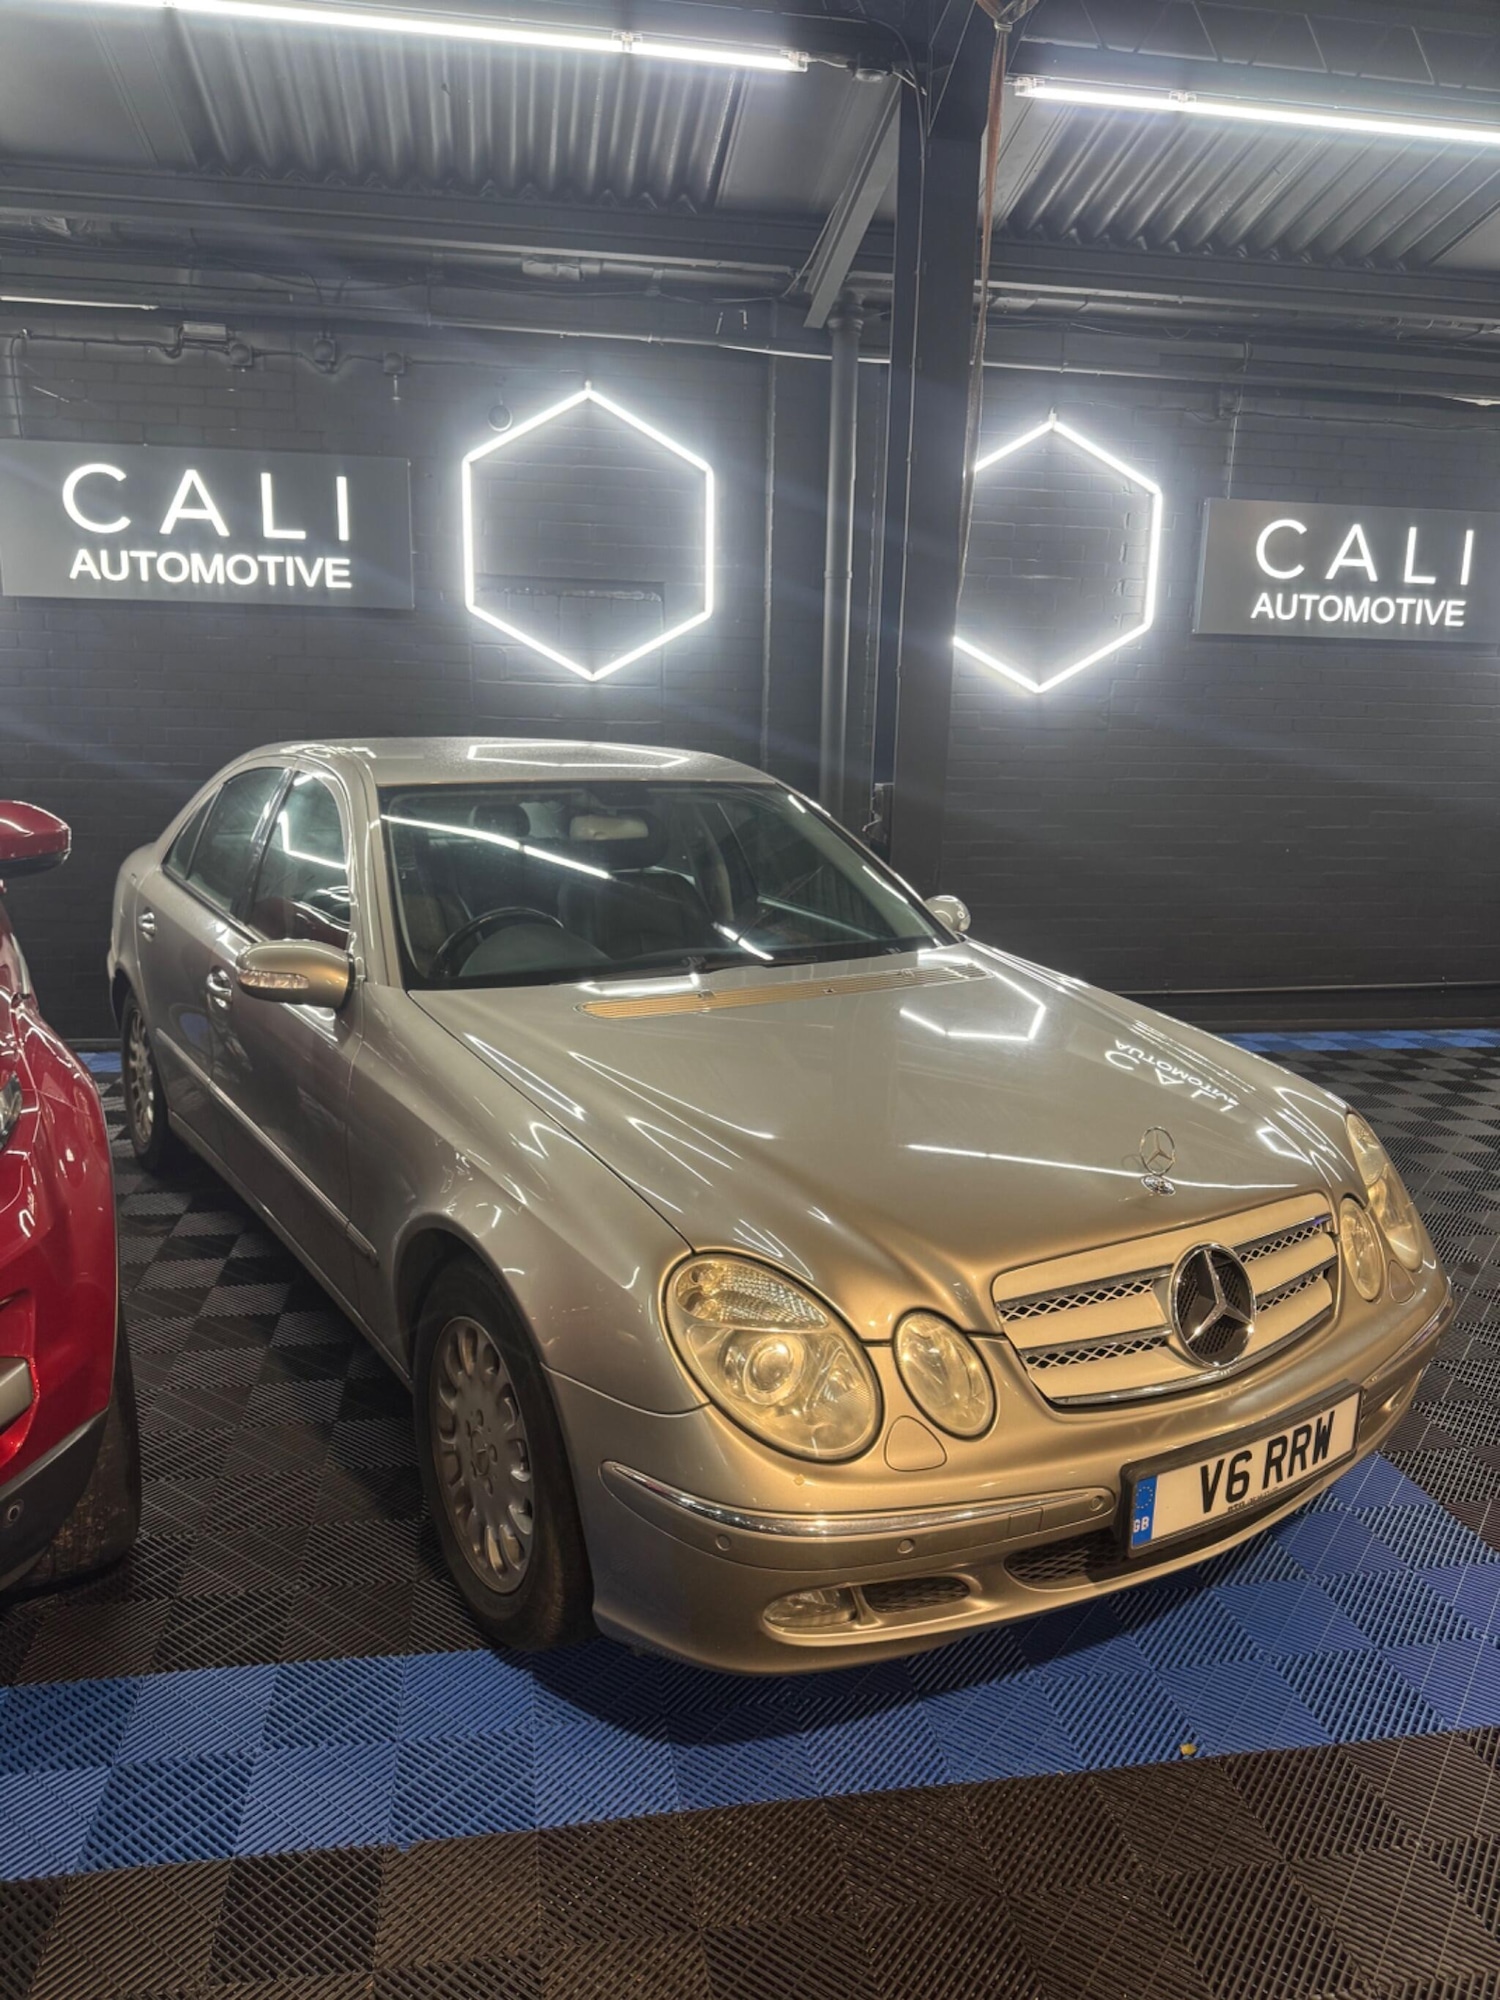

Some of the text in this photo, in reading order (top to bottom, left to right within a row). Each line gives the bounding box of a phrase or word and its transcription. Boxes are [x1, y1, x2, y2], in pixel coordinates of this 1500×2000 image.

[62, 463, 350, 541] CALI
[69, 548, 352, 589] AUTOMOTIVE
[1255, 518, 1475, 586] CALI
[1250, 592, 1466, 627] AUTOMOTIVE
[1200, 1410, 1335, 1514] V6 RRW
[1132, 1515, 1150, 1533] GB
